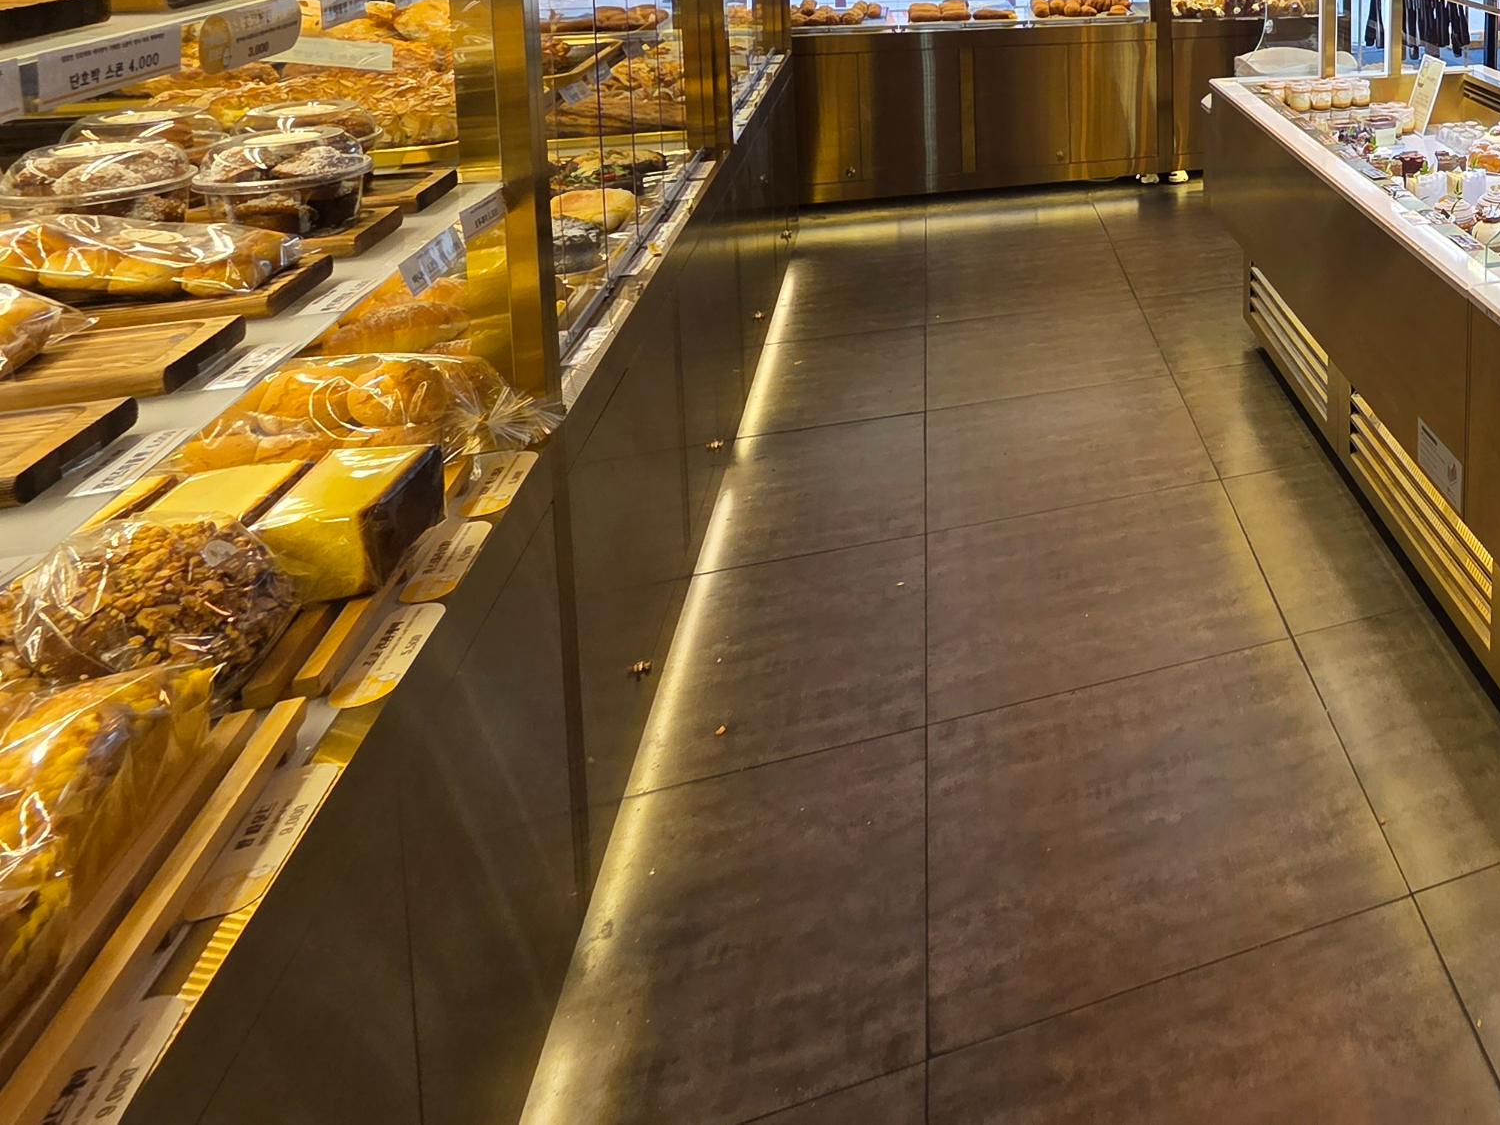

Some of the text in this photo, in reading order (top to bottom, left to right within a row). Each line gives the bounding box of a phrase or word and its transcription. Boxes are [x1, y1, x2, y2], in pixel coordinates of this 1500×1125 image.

[69, 53, 160, 91] 단호박 스콘 4,000
[401, 634, 423, 657] 5,500
[278, 804, 309, 837] 9,000
[95, 1065, 140, 1121] 9,000
